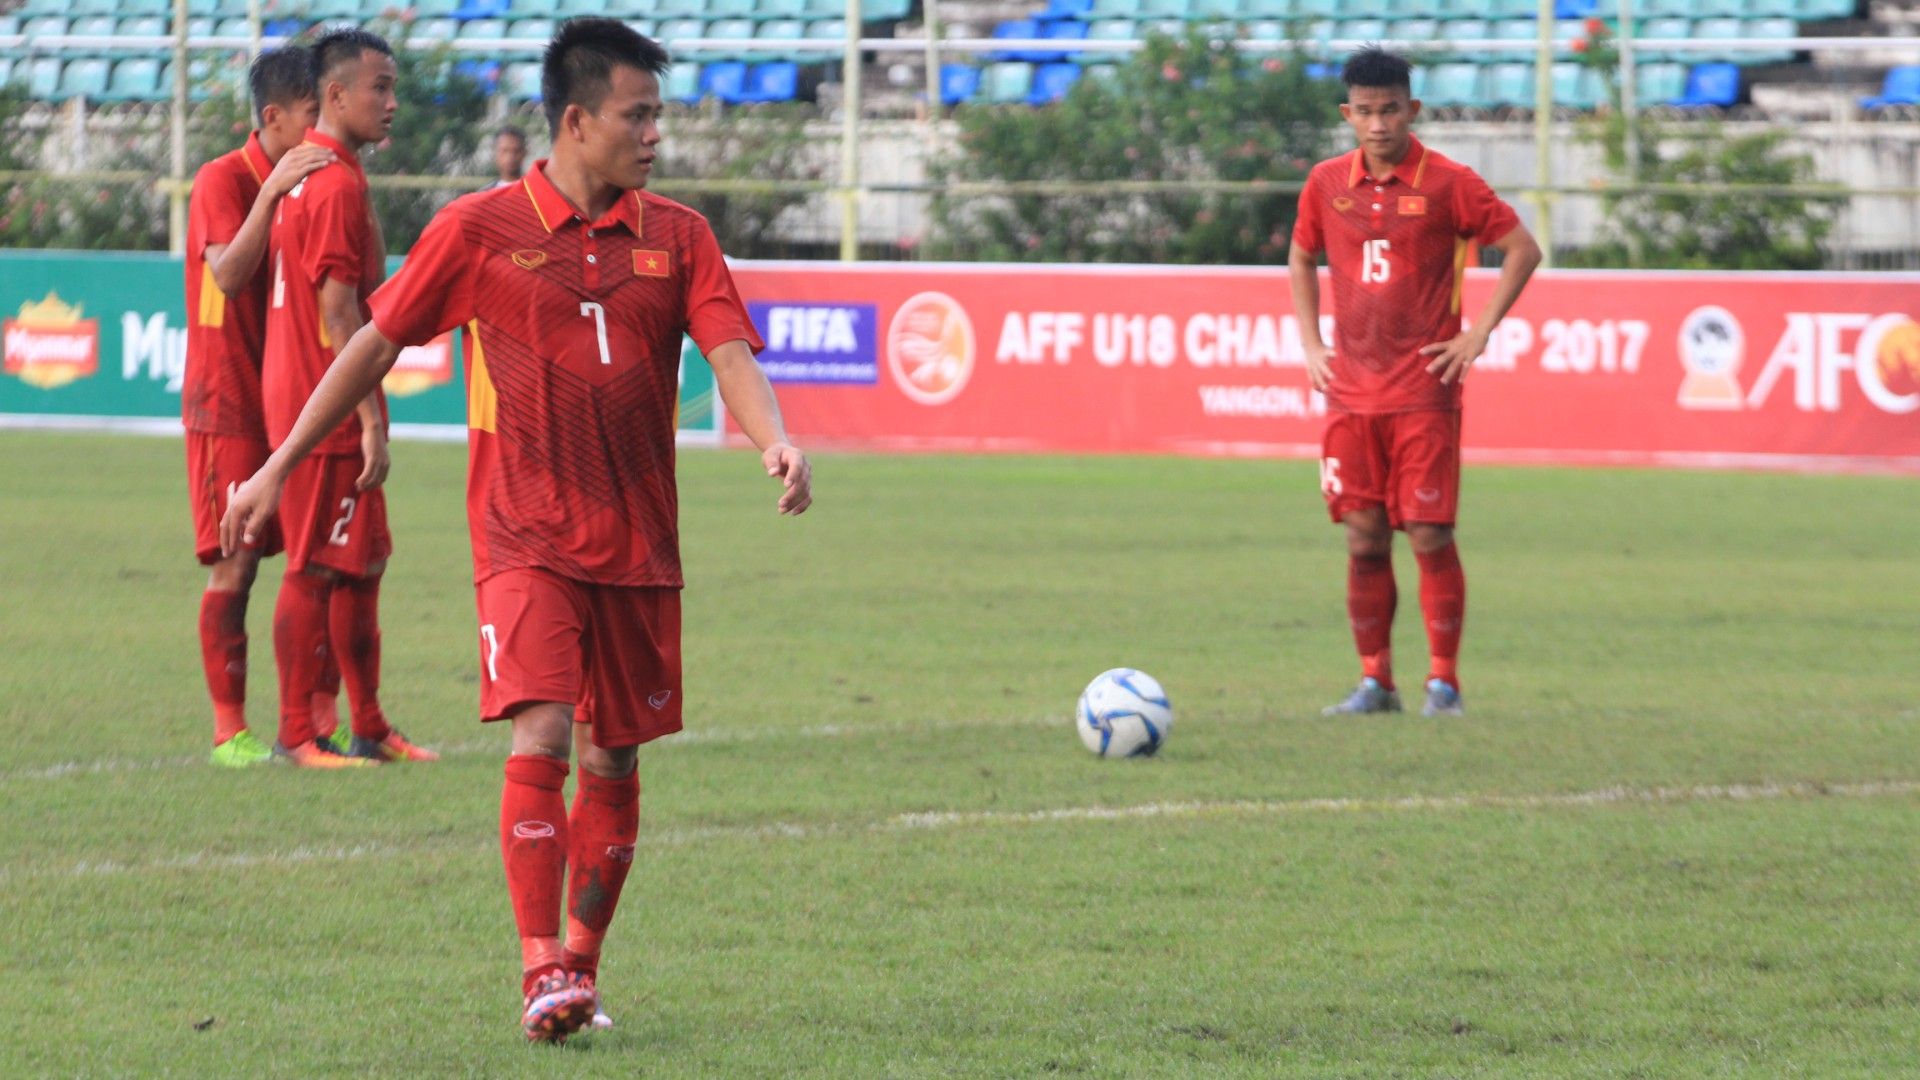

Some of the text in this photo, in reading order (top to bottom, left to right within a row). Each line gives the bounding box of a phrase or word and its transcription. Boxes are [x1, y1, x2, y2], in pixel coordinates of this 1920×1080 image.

[1362, 239, 1391, 284] 15
[580, 302, 612, 364] 7
[767, 306, 859, 353] FIFA
[995, 311, 1085, 364] AFF
[1093, 312, 1178, 367] U18
[1539, 317, 1650, 373] 2017
[1746, 311, 1920, 415] AFC
[329, 497, 356, 547] 2
[481, 623, 499, 682] 7
